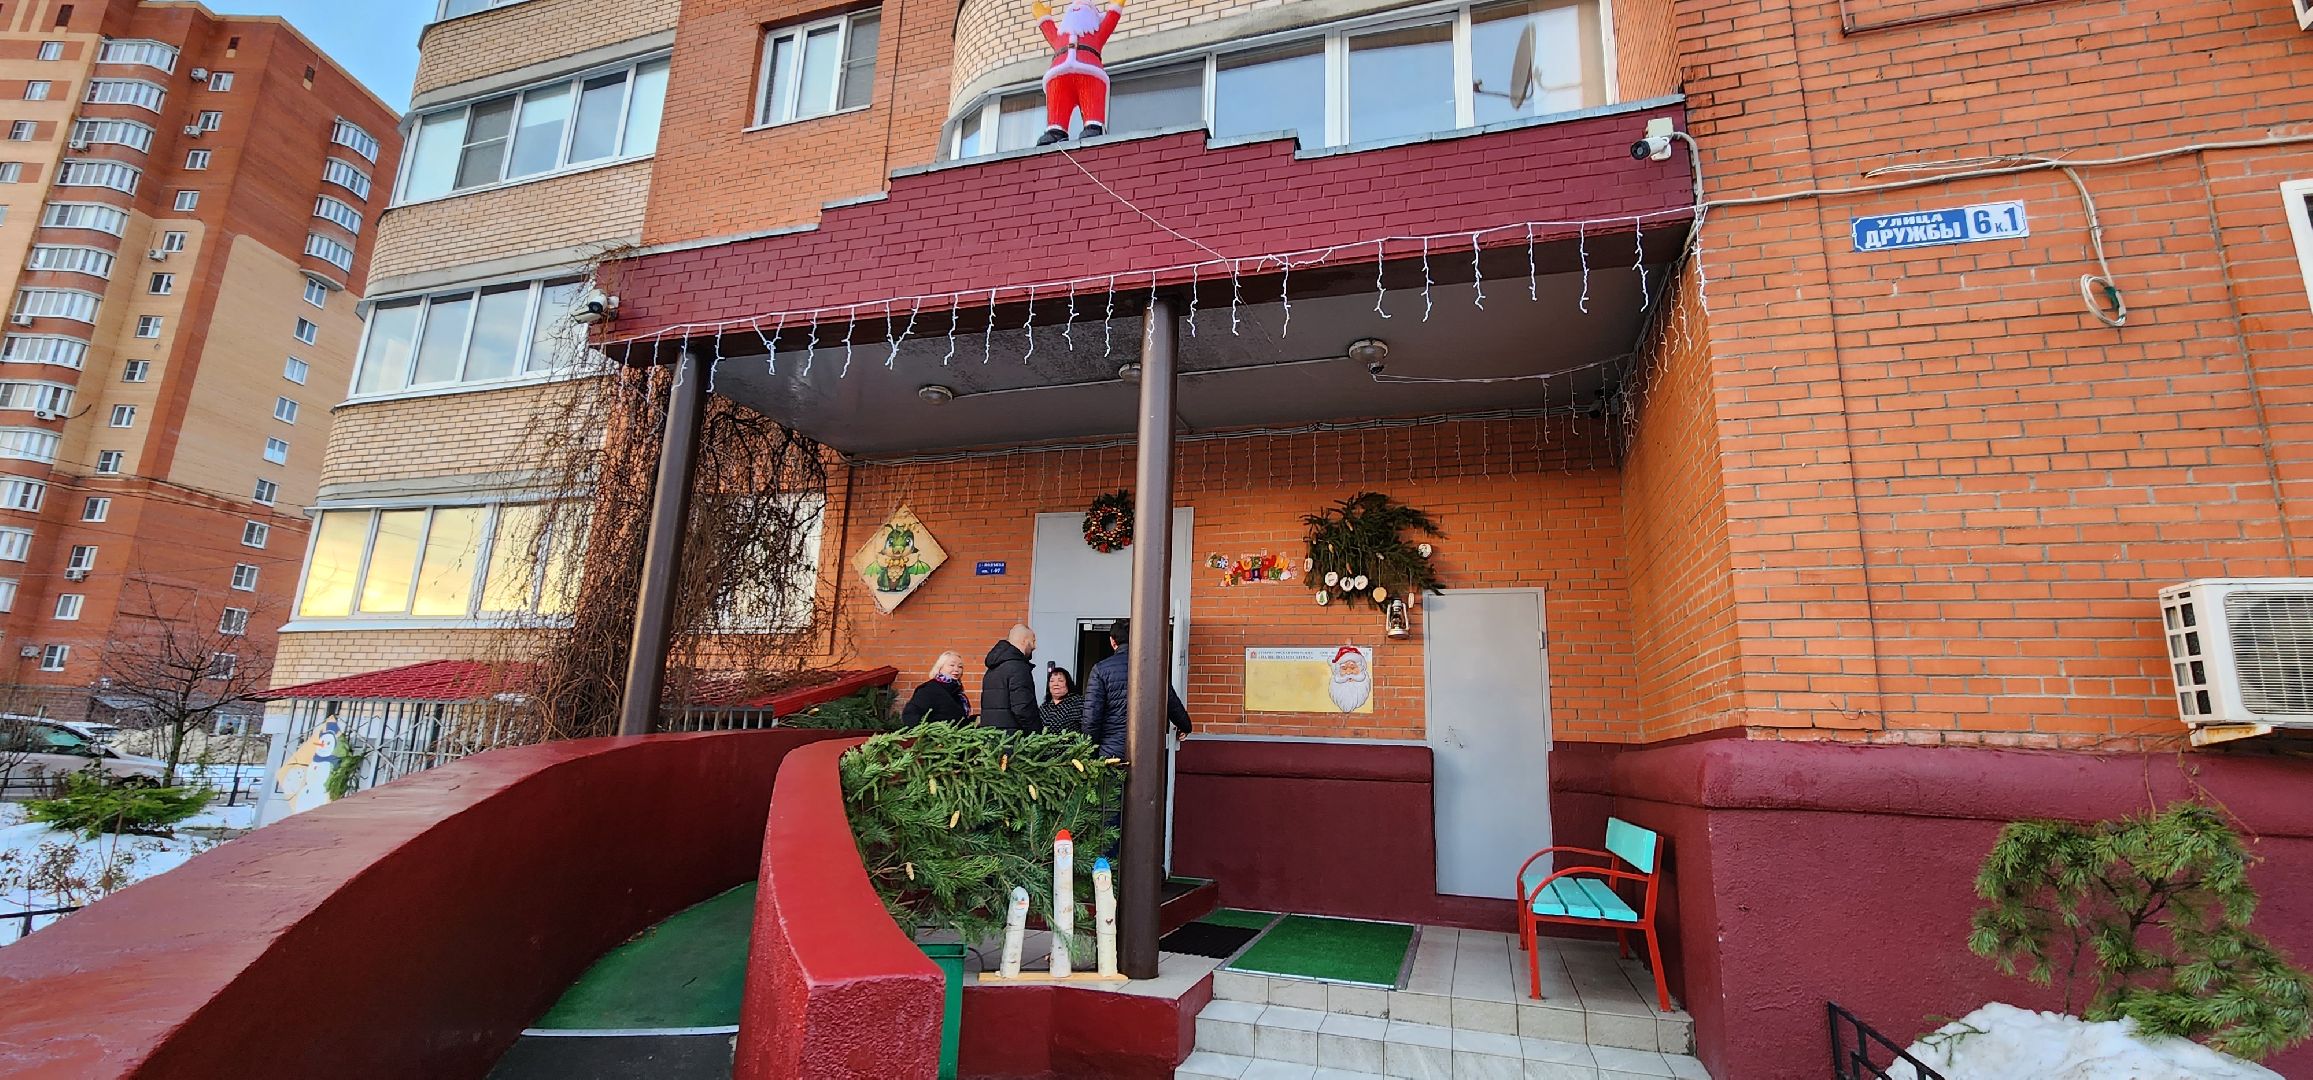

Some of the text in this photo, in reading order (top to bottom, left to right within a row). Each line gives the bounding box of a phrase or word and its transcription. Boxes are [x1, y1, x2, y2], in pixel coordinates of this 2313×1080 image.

[1876, 212, 1944, 228] УЛИЦА
[1973, 209, 1992, 234] 6
[1864, 221, 1962, 249] ДРУЖБЫ
